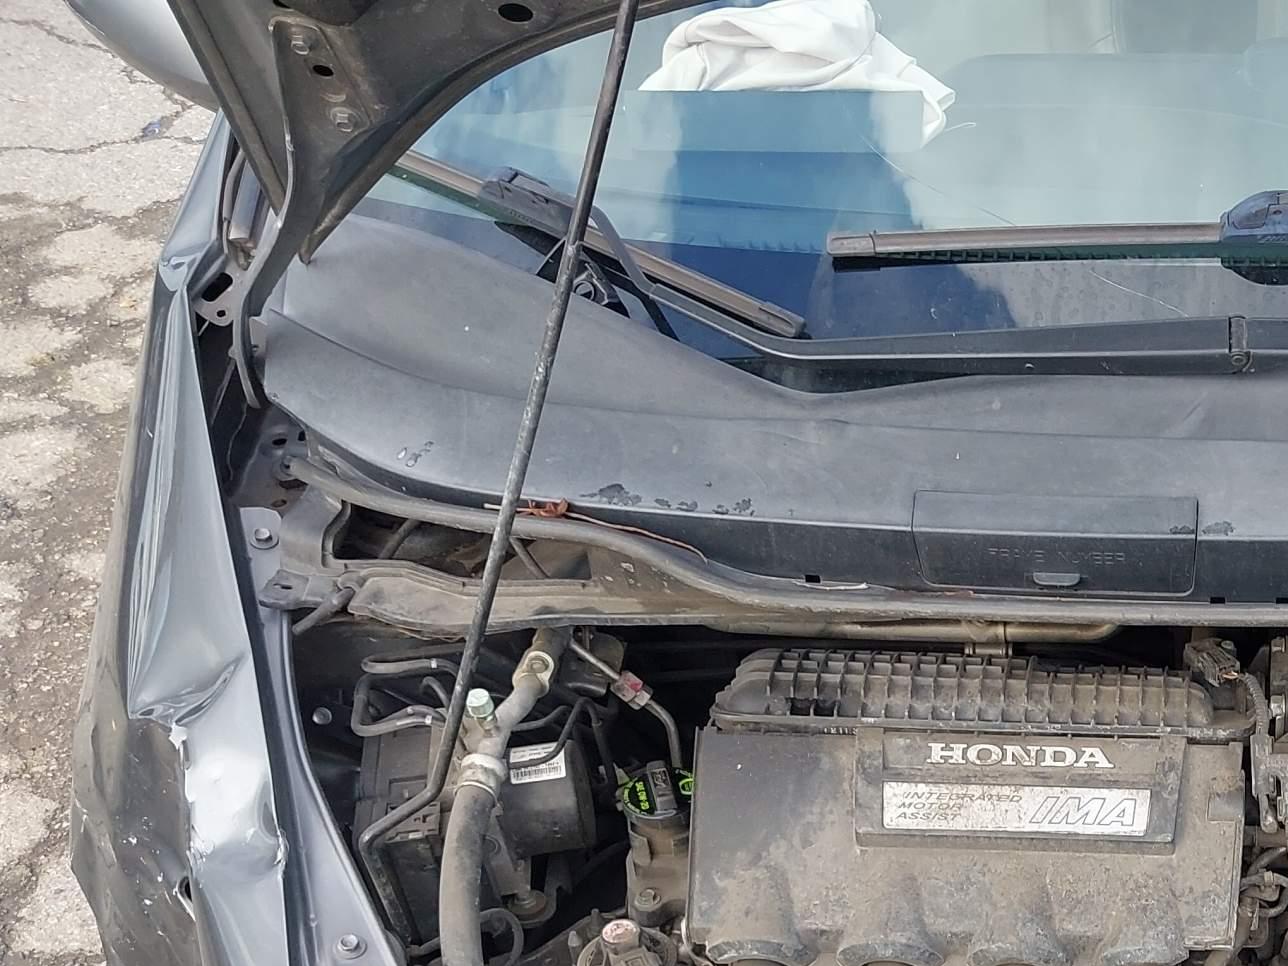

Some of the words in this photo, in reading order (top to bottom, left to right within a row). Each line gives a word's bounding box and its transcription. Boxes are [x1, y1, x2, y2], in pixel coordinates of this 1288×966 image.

[926, 742, 1114, 768] HONDA
[903, 791, 1023, 803] INTEGRATED
[899, 801, 963, 811] MOTOR
[1029, 796, 1137, 826] IMA
[896, 811, 961, 821] ASSIST
